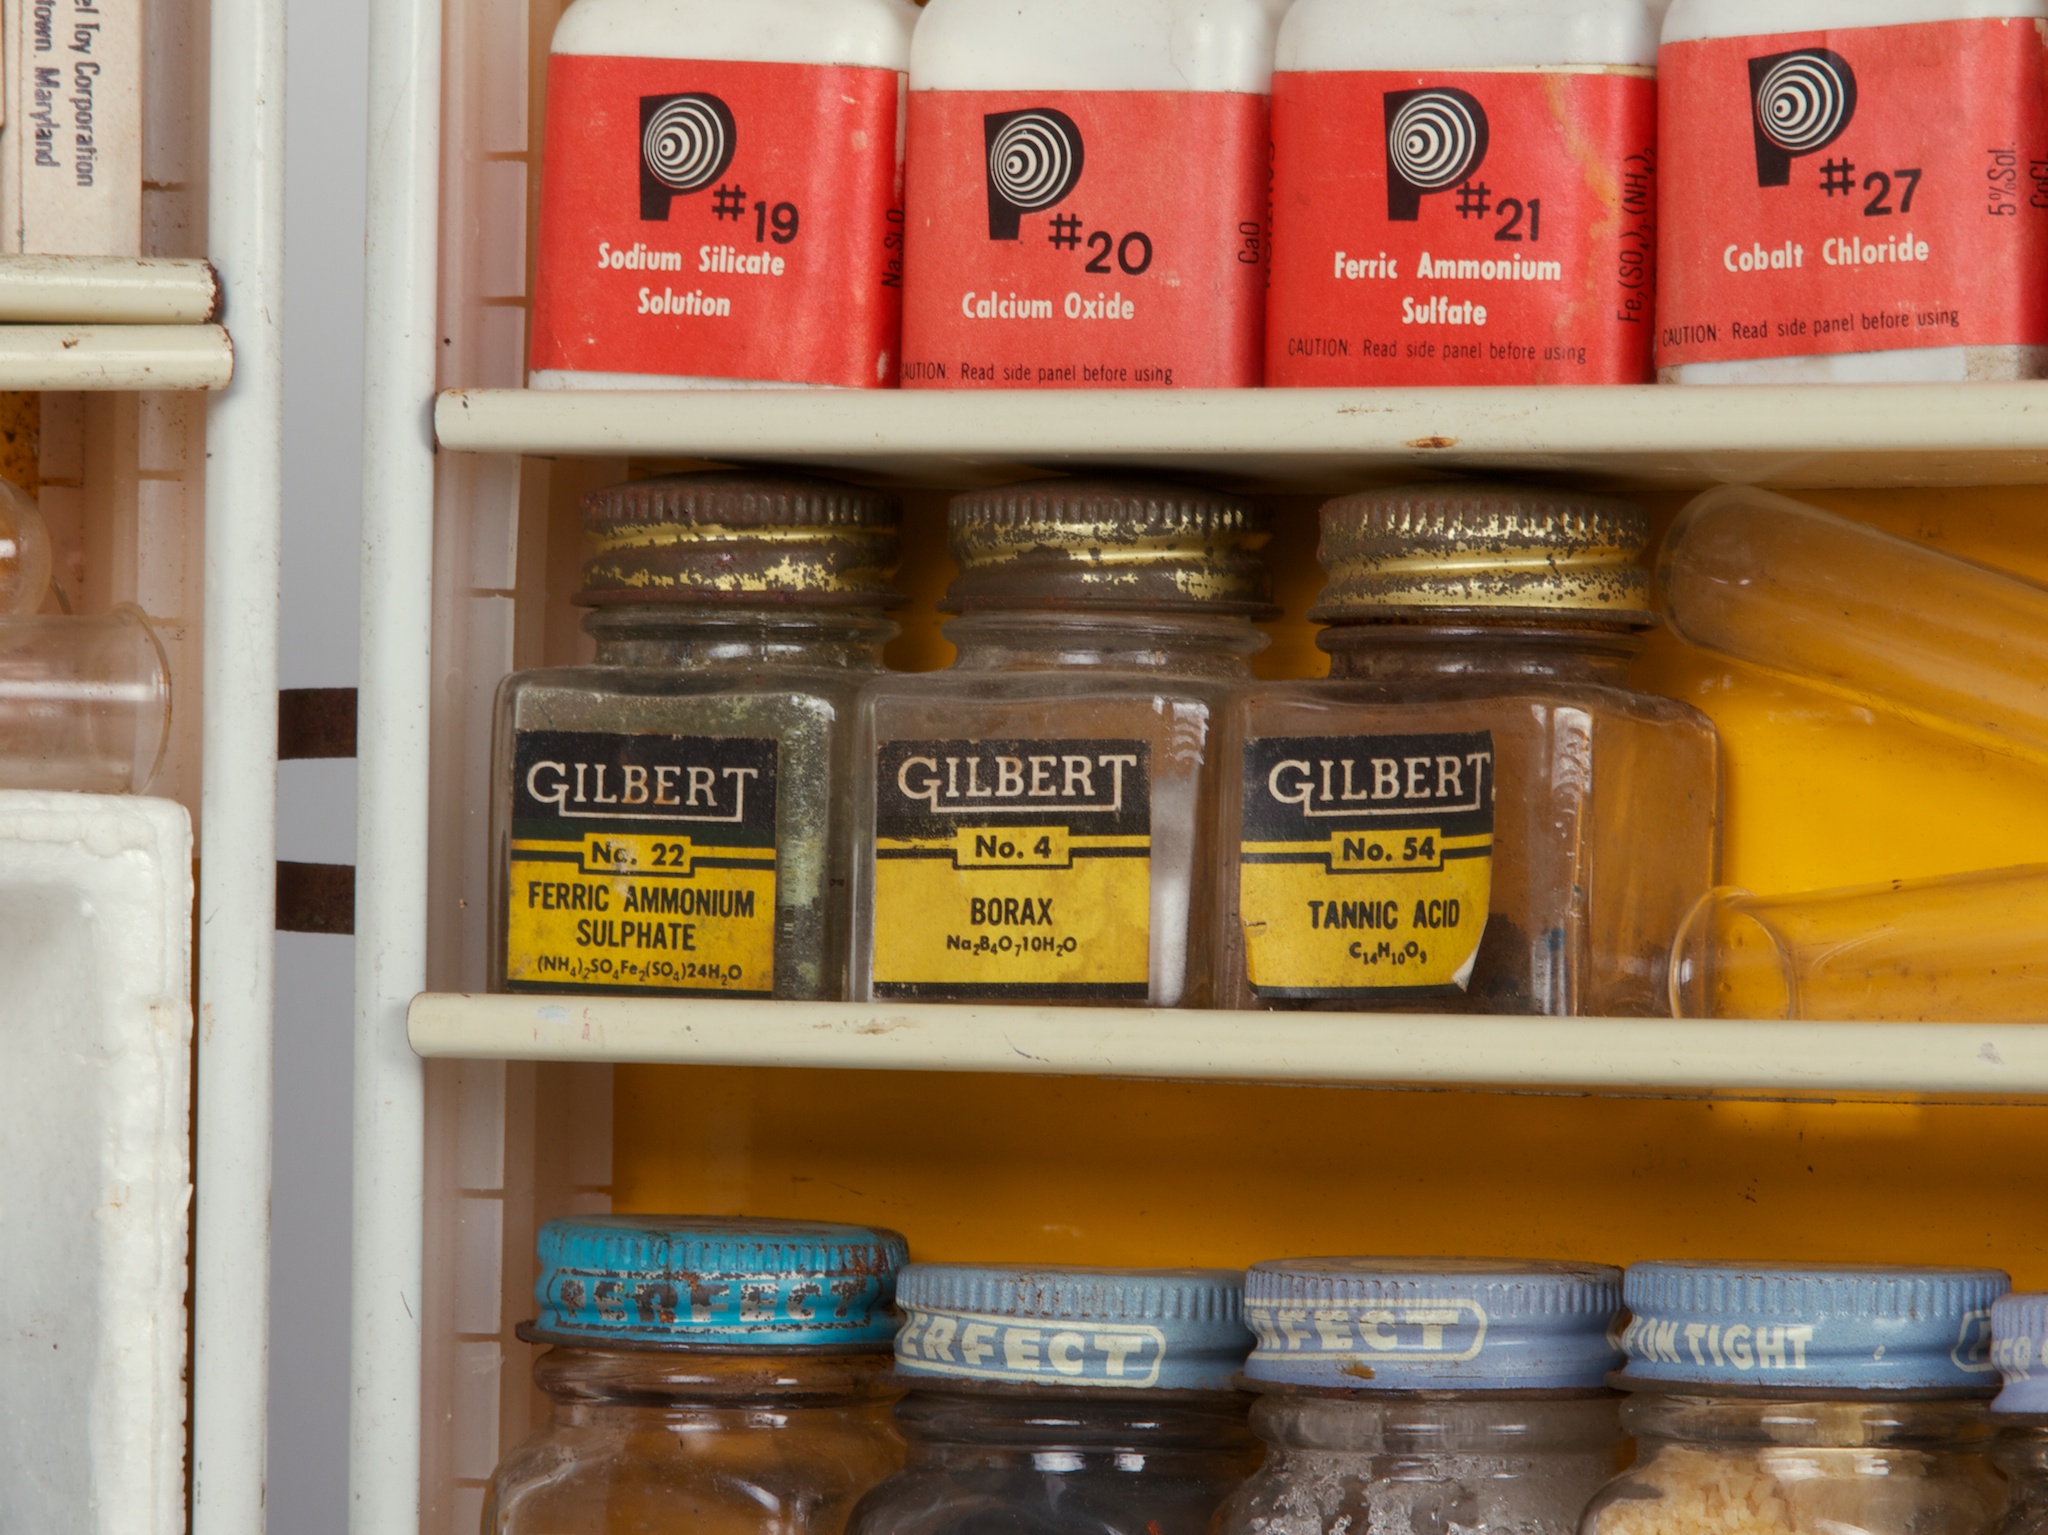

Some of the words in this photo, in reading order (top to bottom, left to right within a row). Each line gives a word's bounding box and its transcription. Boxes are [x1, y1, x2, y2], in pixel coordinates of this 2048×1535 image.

[68, 23, 100, 54] Toy
[29, 67, 60, 167] Maryland
[69, 61, 101, 187] Corporation
[1819, 157, 1922, 217] #27
[711, 183, 799, 245] #19
[1455, 181, 1540, 241] #21
[597, 242, 682, 271] Sodium
[698, 245, 786, 277] Silicate
[1048, 213, 1154, 276] #20
[1237, 221, 1261, 264] CaO
[1723, 241, 1804, 273] Cobalt
[1822, 232, 1930, 267] Chloride
[1334, 251, 1398, 279] Ferric
[1416, 252, 1562, 281] Ammonium
[637, 287, 731, 317] Solution
[962, 292, 1053, 319] Calcium
[1063, 291, 1135, 320] Oxide
[1401, 296, 1488, 326] Sulfate
[1662, 325, 1722, 347] CAUTION:
[1732, 319, 1768, 340] Read
[1777, 318, 1807, 337] side
[1813, 313, 1855, 338] panel
[1861, 310, 1910, 331] before
[1917, 308, 1960, 330] using
[1288, 338, 1352, 357] CAUTION:
[1363, 339, 1397, 357] Read
[1406, 341, 1436, 358] side
[1442, 342, 1483, 361] panel
[1489, 341, 1536, 361] before
[1544, 344, 1587, 365] using
[961, 363, 995, 381] Read
[1003, 363, 1032, 381] side
[1038, 364, 1076, 383] panel
[1083, 364, 1128, 382] before
[1134, 366, 1174, 385] using
[526, 760, 759, 823] GILBERT
[898, 754, 1137, 814] GILBERT
[1268, 752, 1491, 817] GILBERT
[591, 841, 638, 867] No.
[651, 843, 684, 866] 22
[975, 835, 1024, 859] No.
[1034, 836, 1051, 858] 4
[1343, 838, 1393, 862] No.
[1403, 837, 1436, 861] 54
[528, 881, 610, 911] FERRIC
[624, 887, 755, 918] AMMONIUM
[971, 897, 1053, 926] BORAX
[1308, 900, 1398, 930] TANNIC
[1413, 899, 1460, 928] ACID
[576, 919, 696, 951] SULPHATE
[1637, 1317, 1681, 1364] ON
[1684, 1323, 1813, 1371] TIGHT
